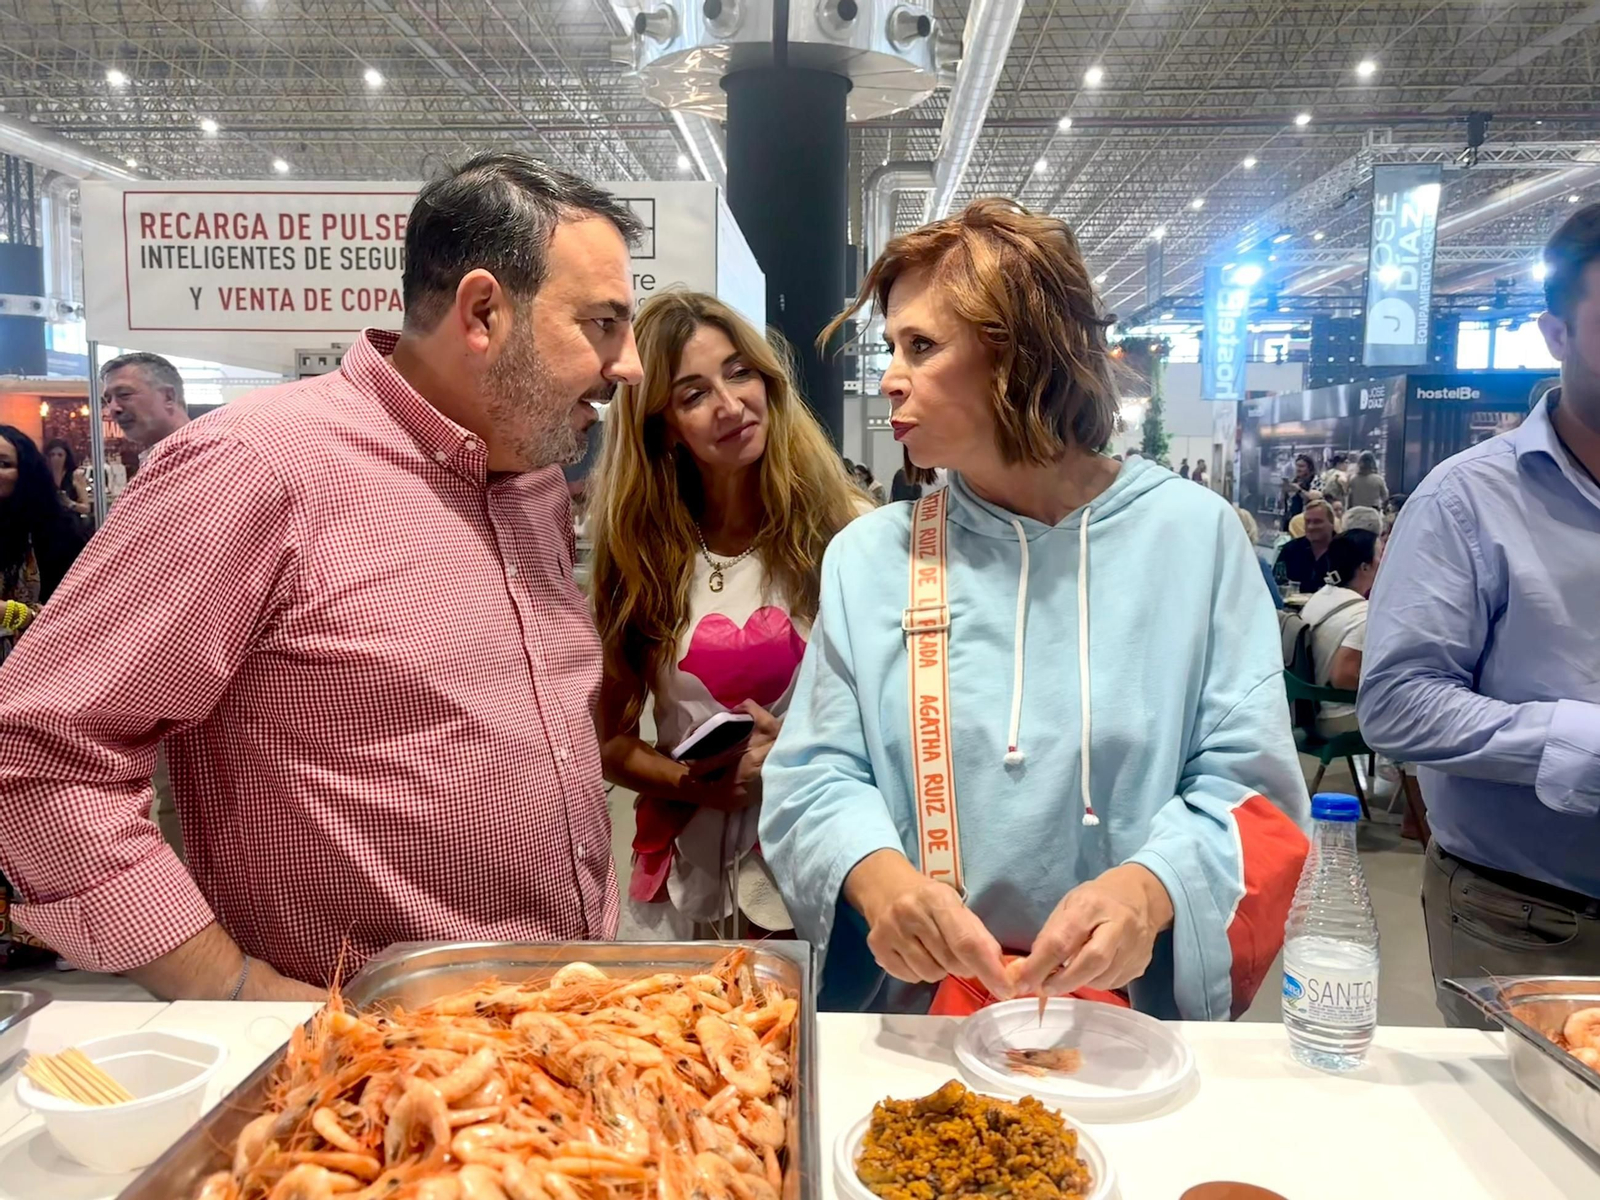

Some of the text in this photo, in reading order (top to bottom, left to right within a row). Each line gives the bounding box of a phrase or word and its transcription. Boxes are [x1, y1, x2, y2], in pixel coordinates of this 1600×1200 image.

[140, 212, 407, 241] RECARGA DE PULSE
[141, 245, 295, 270] INTELIGENTES
[305, 246, 332, 270] DE
[189, 287, 403, 311] Y VENTA DE COPA
[1417, 262, 1433, 345] EQUIPAMIENTO
[1416, 386, 1480, 400] hostelBe
[918, 528, 937, 559] RUIZ
[918, 566, 938, 588] DE
[919, 695, 941, 763] AGATHA
[924, 773, 946, 817] RUIZ
[927, 828, 949, 854] DE
[1307, 978, 1373, 1006] SANTO
